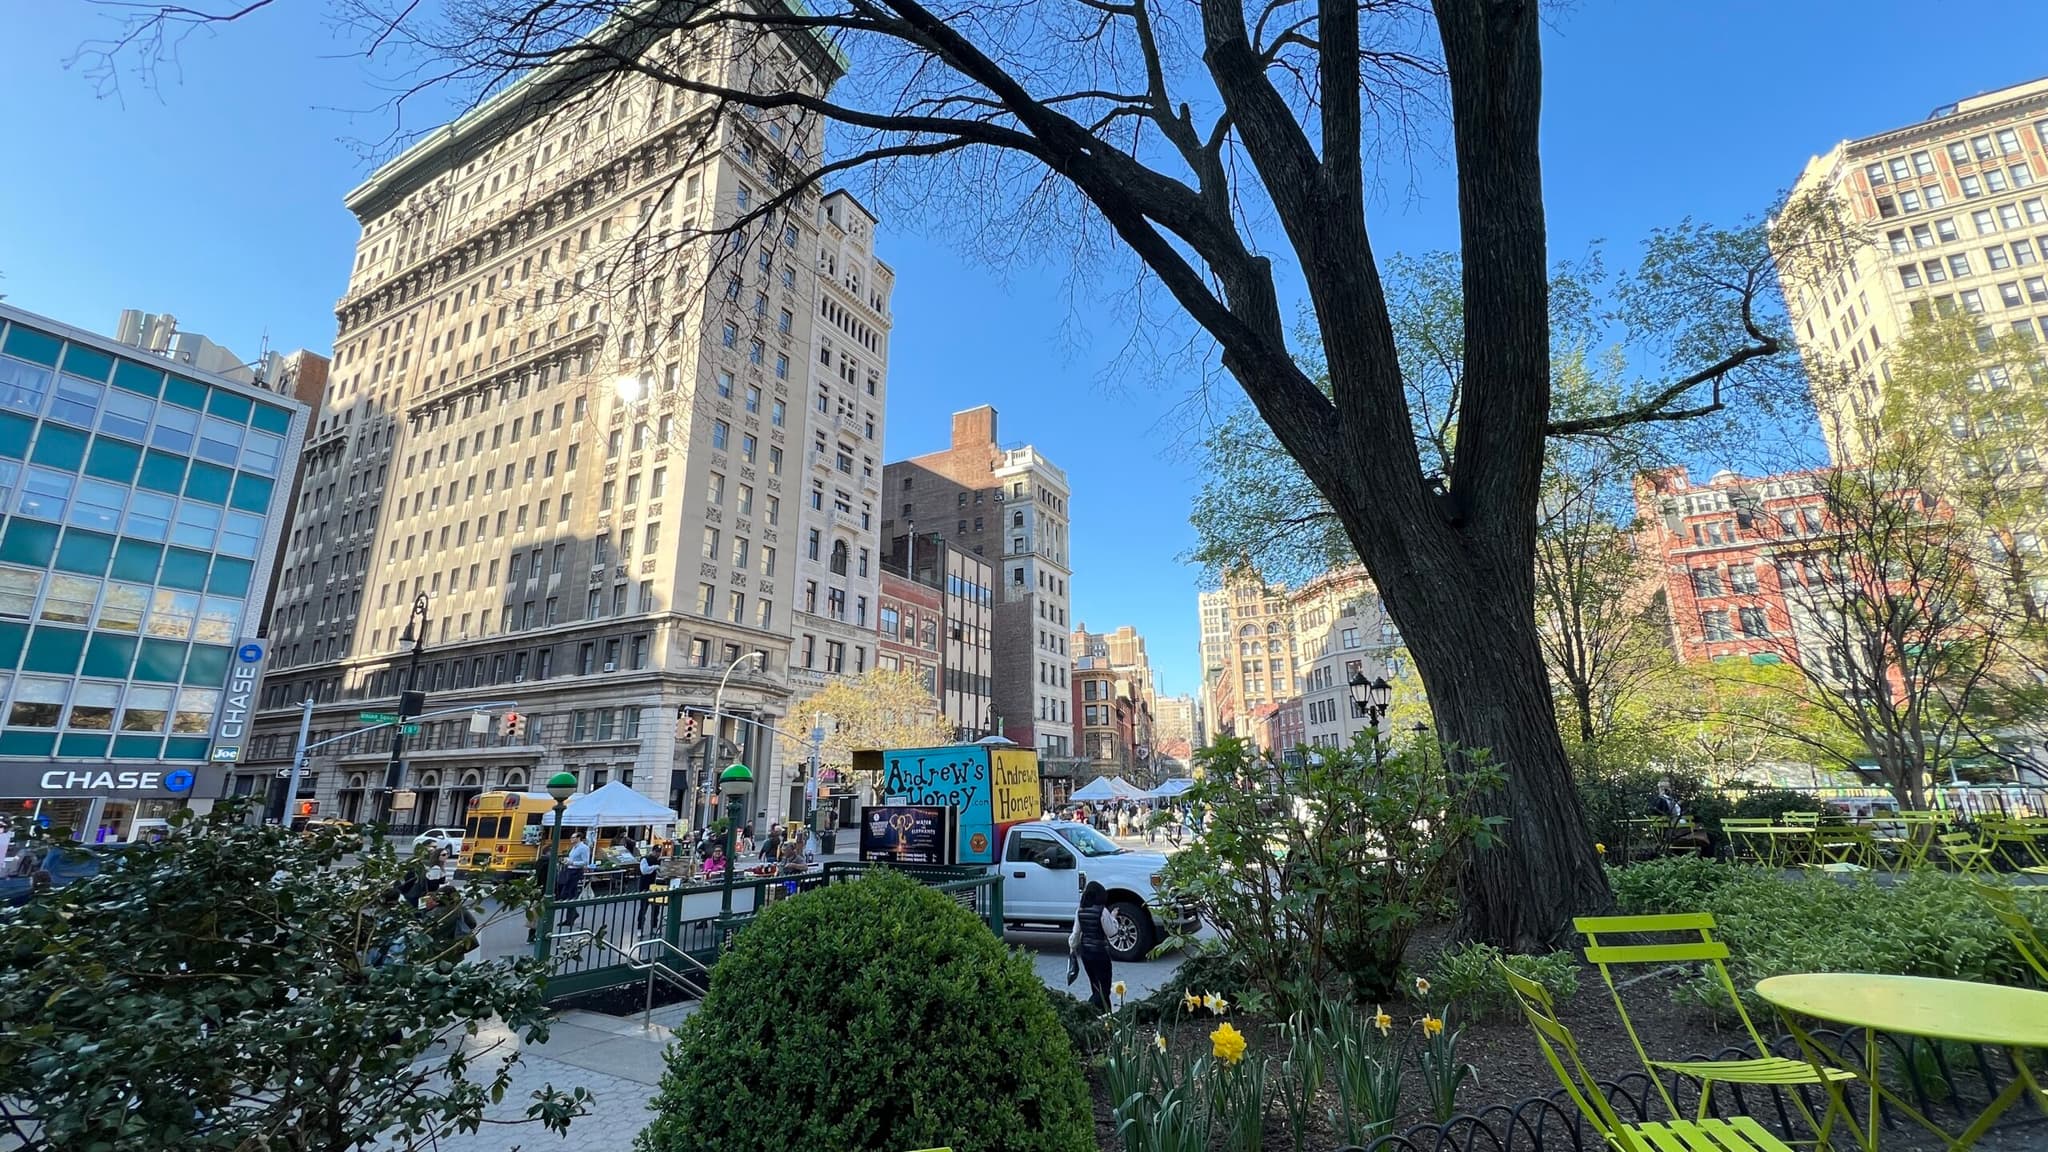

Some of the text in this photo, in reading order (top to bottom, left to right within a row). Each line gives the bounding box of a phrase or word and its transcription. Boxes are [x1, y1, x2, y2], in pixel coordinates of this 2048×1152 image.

[221, 666, 257, 738] CHASE
[40, 771, 162, 789] CHASE
[994, 755, 1038, 785] Andrew's
[999, 788, 1035, 819] Honey
